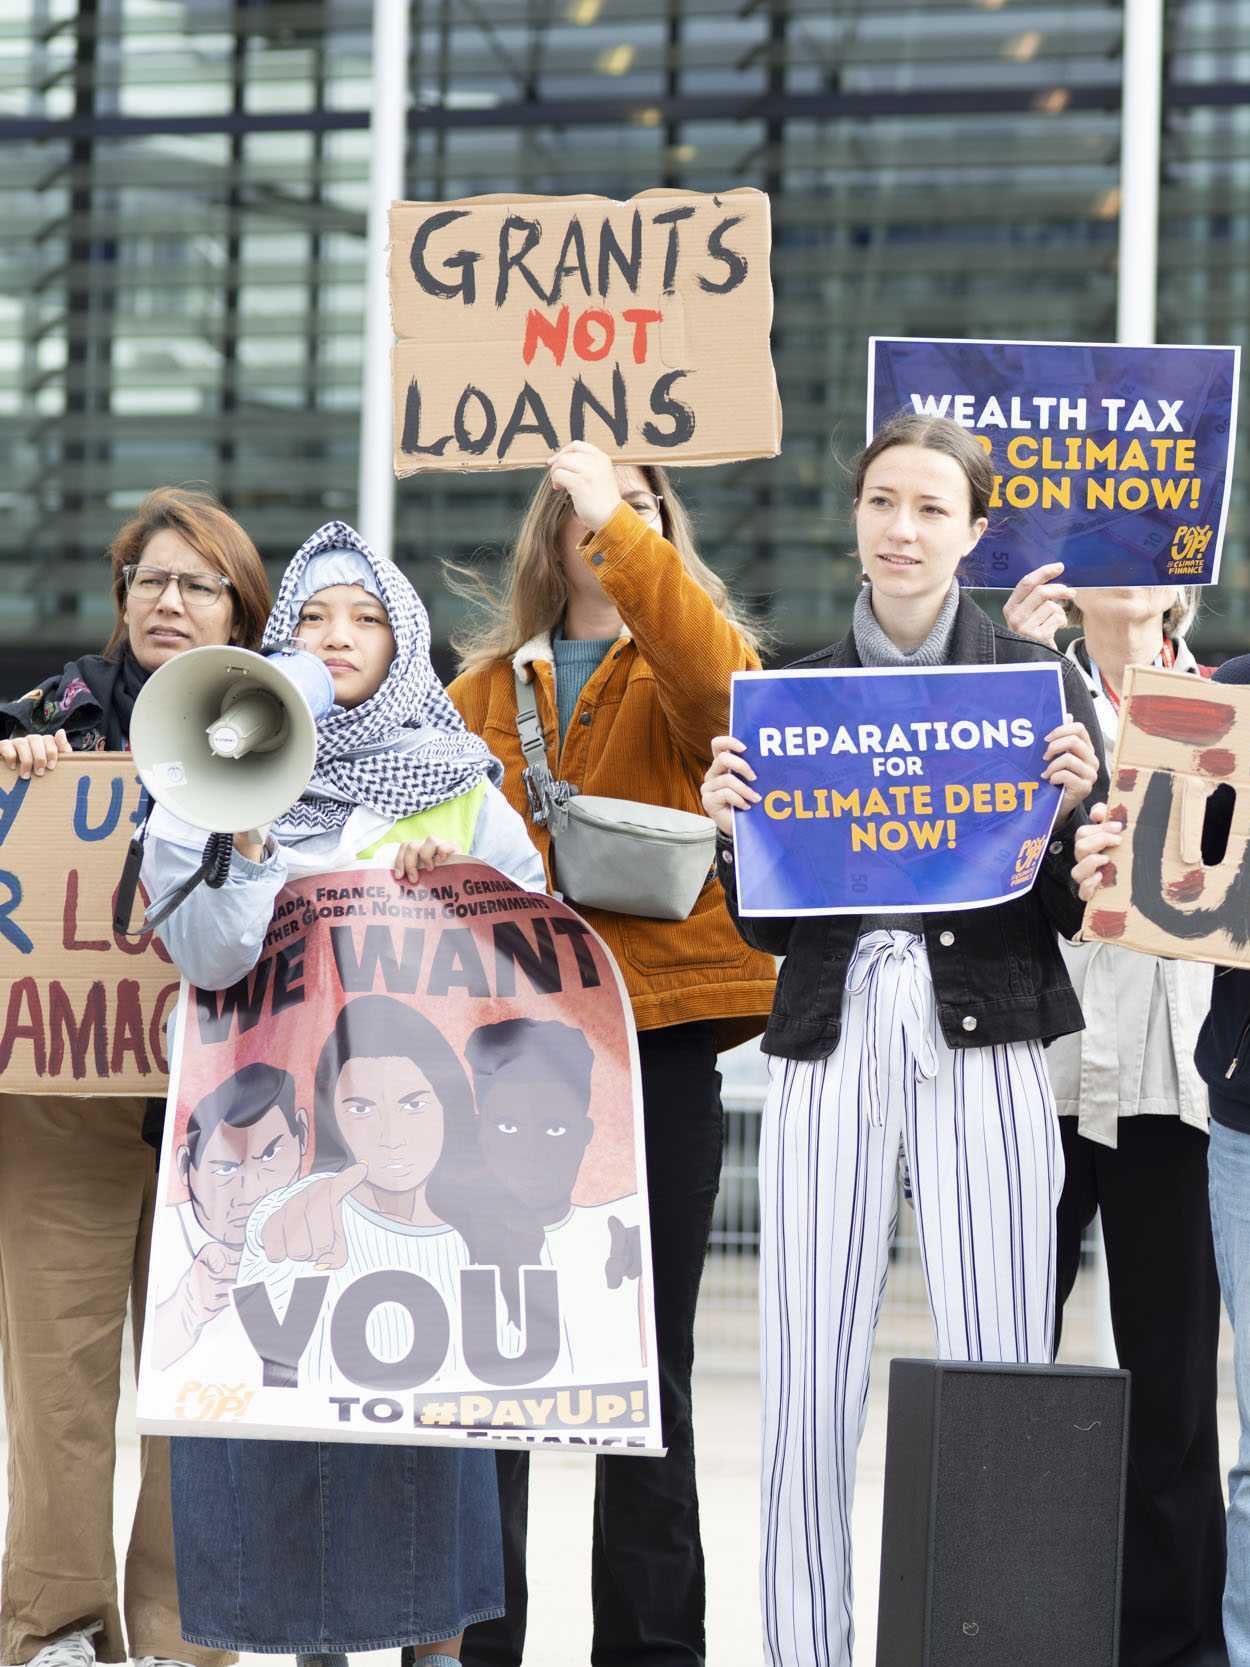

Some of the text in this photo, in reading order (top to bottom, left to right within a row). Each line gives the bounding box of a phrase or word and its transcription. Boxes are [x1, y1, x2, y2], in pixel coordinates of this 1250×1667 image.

[522, 304, 663, 368] NOT
[401, 362, 696, 461] LOANS
[911, 394, 1087, 431] WEALTH
[1101, 398, 1184, 432] TAX
[1007, 436, 1196, 471] CLIMATE
[1087, 477, 1201, 510] NOW!
[758, 718, 1035, 757] REPARATIONS
[872, 756, 924, 777] FOR
[763, 782, 1039, 821] CLIMATE DEBT
[851, 820, 957, 853] NOW!
[316, 886, 391, 902] FRANCE,
[400, 885, 459, 902] JAPAN,
[262, 920, 300, 948] THER
[303, 903, 366, 926] GLOBAL
[372, 901, 436, 920] NORTH
[196, 917, 601, 1045] WE WANT
[233, 1268, 561, 1392] YOU
[329, 1397, 404, 1424] TO
